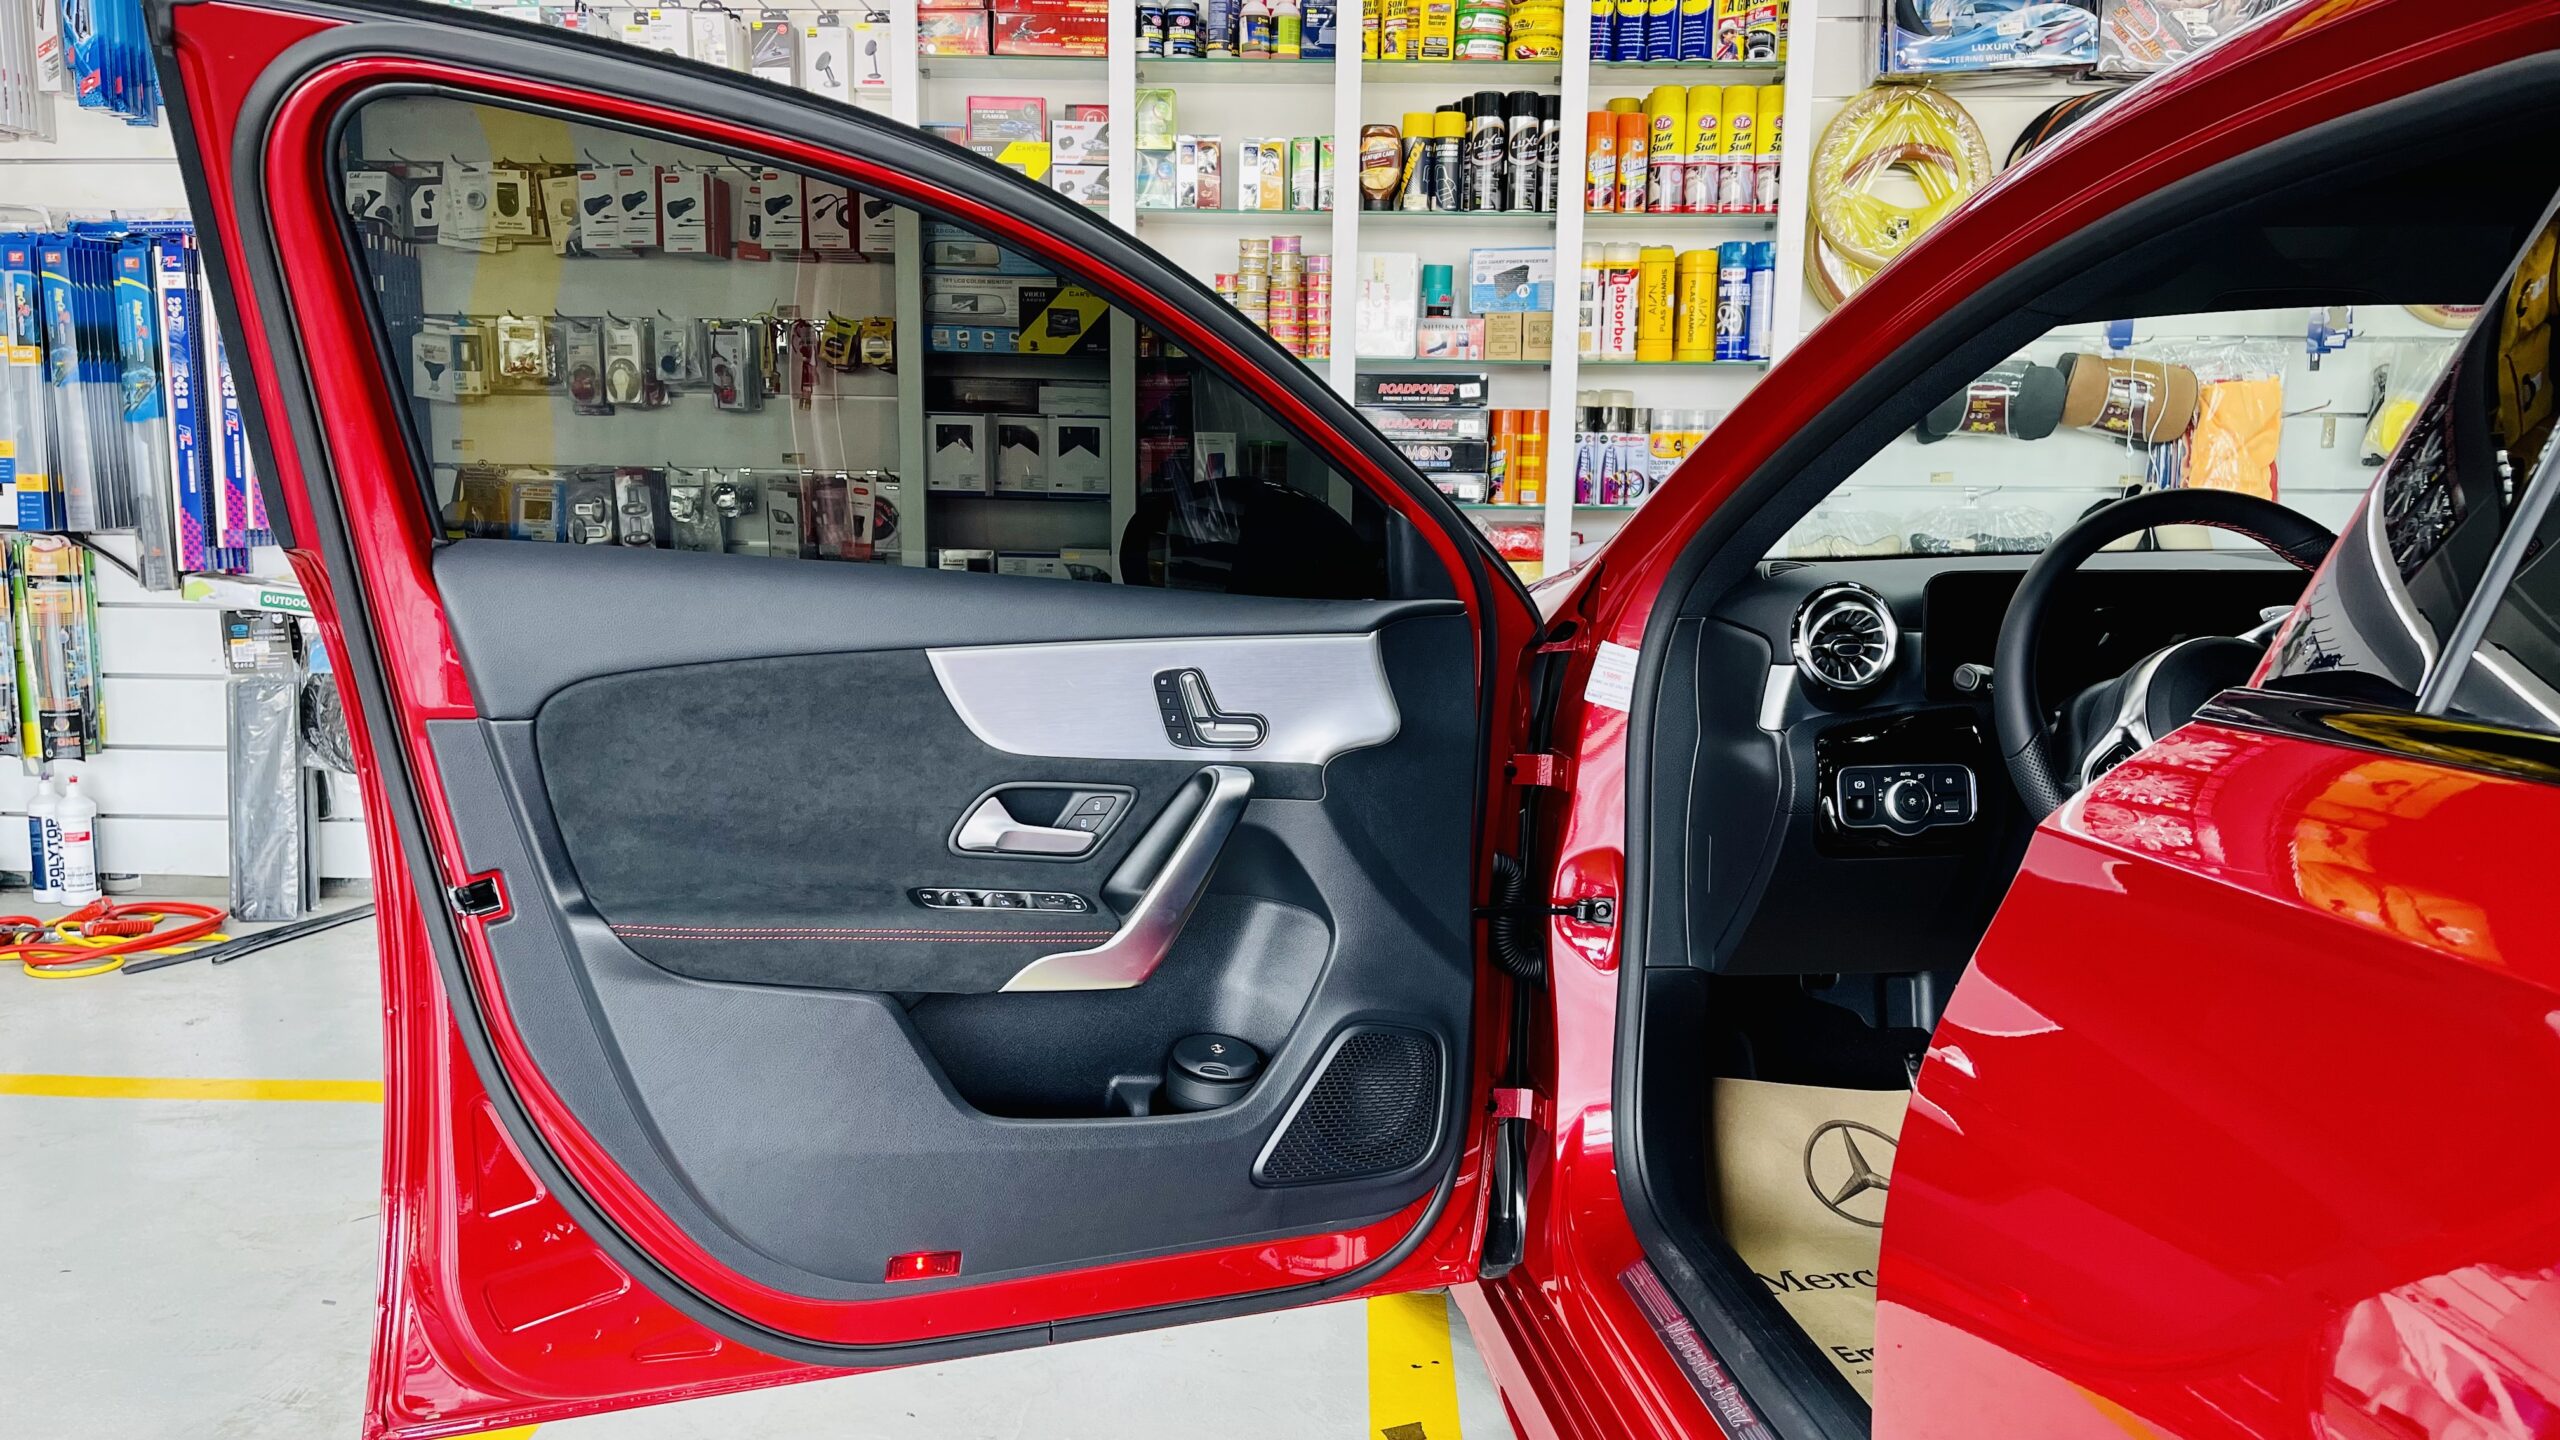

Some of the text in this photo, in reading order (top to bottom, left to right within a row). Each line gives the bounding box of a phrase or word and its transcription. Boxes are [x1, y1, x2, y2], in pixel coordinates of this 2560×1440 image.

[1972, 43, 2016, 52] LUXURY
[1946, 55, 1984, 65] STEERING
[1985, 53, 2012, 62] WHEEL
[1656, 118, 1672, 129] STP
[1699, 118, 1717, 129] STP
[1734, 118, 1752, 129] STP
[1654, 133, 1673, 143] Tuff
[1699, 133, 1717, 142] Tuff
[1733, 133, 1752, 142] Tuff
[1651, 143, 1674, 153] Stuff
[1694, 143, 1717, 152] Stuff
[1728, 143, 1752, 152] Stuff
[1612, 286, 1627, 352] absorber
[1687, 305, 1695, 343] CHAMOIS
[1377, 383, 1455, 395] ROADPOWER
[1376, 418, 1454, 430] ROADPOWER
[46, 818, 61, 890] POLYTOP
[1664, 1317, 1753, 1429] Mercedes-Benz
